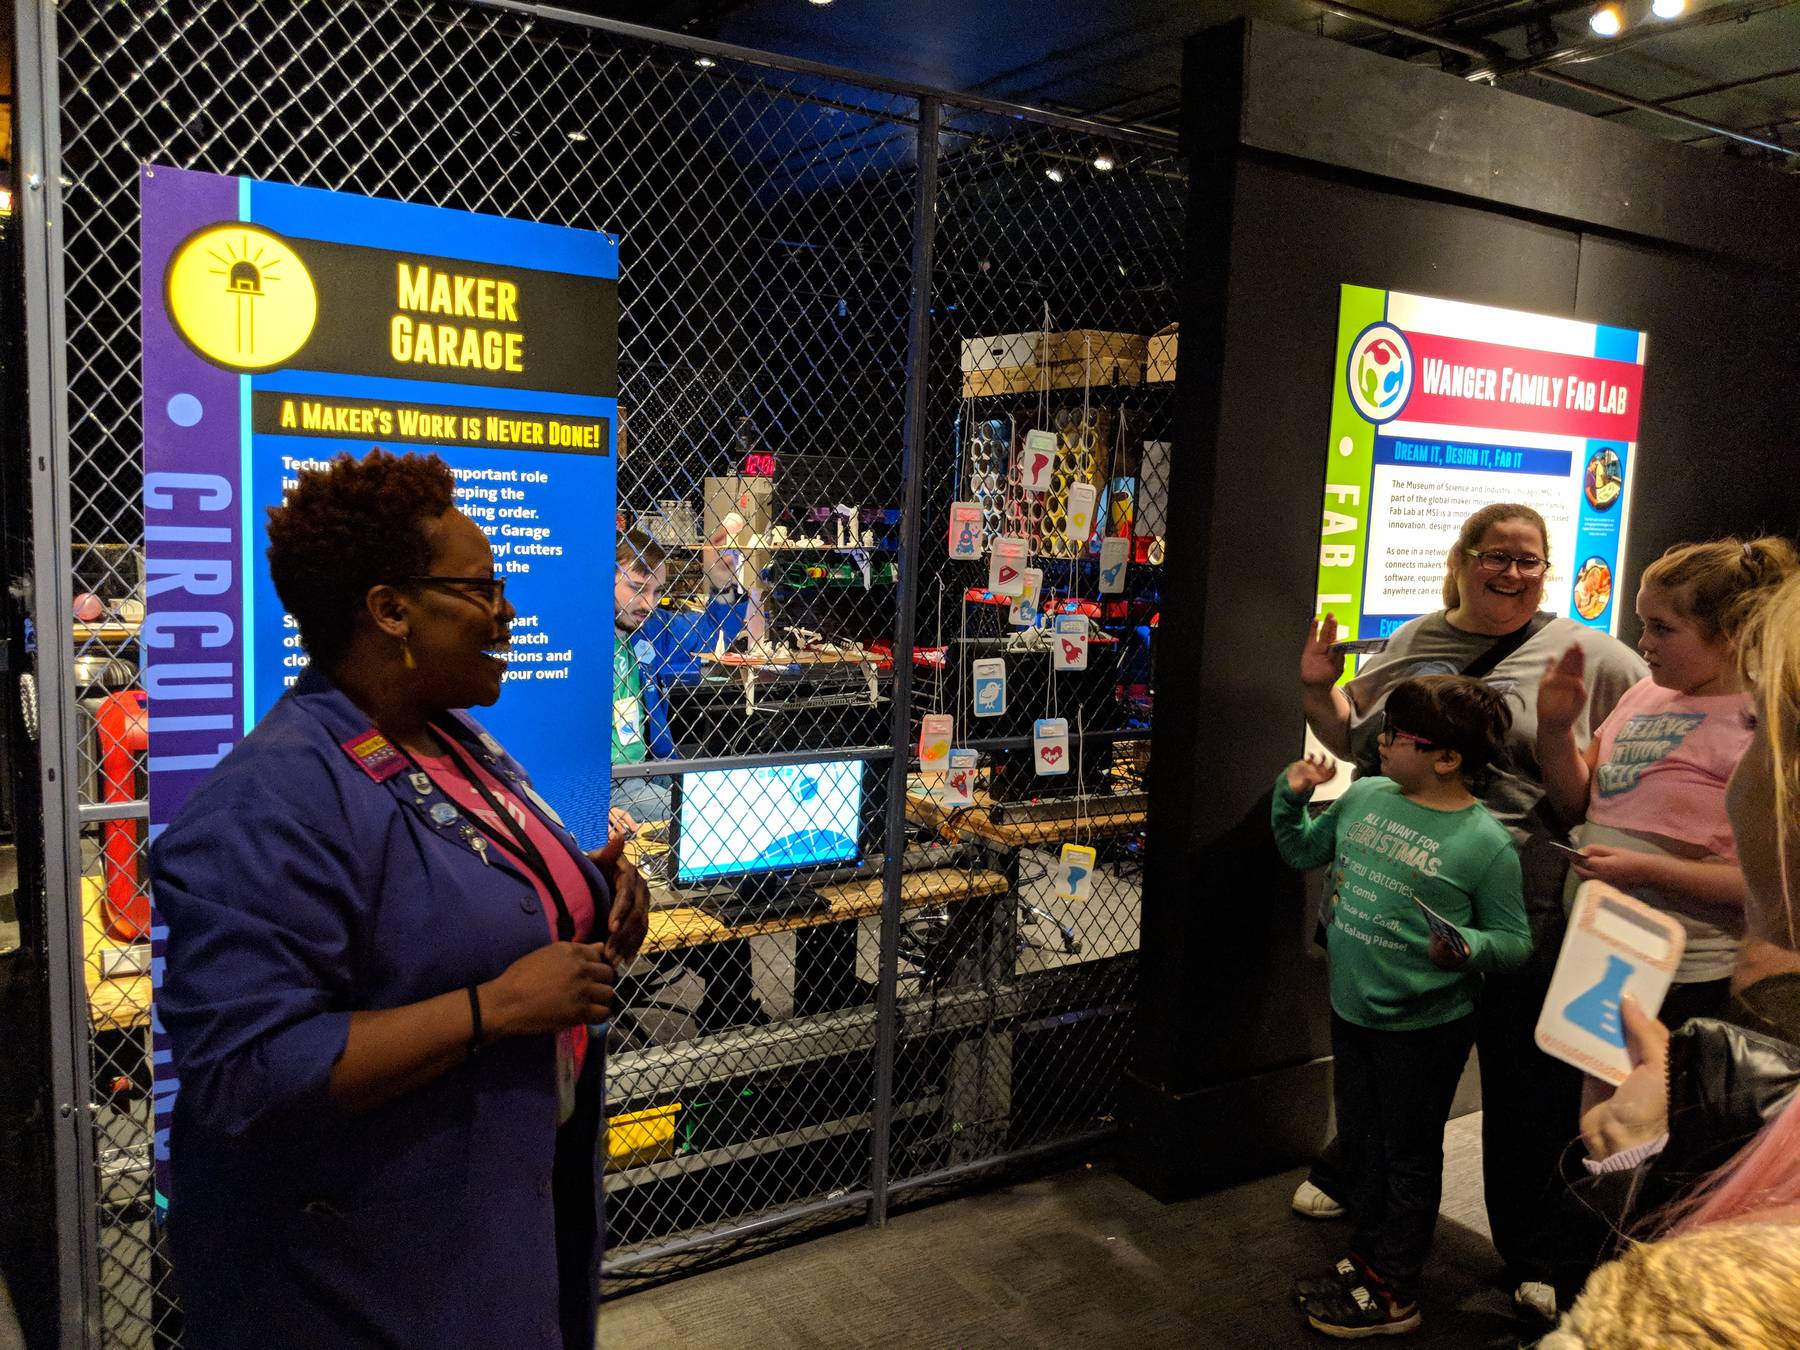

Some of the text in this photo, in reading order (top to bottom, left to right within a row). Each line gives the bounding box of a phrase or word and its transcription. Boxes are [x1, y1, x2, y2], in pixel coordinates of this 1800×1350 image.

[397, 262, 519, 322] MAKER
[390, 314, 525, 373] GARAGE
[1422, 357, 1628, 416] WANGER FAMILY FAB LAB
[280, 400, 601, 449] A MAKER'S WORK IS NEVER DONE!
[1394, 440, 1428, 462] DREAM
[1445, 444, 1479, 466] DESIGN
[1494, 448, 1512, 468] FAB
[1514, 452, 1524, 469] IT
[281, 455, 549, 483] Techn mportant role
[451, 485, 498, 503] eeping
[500, 487, 525, 500] the
[1392, 479, 1405, 489] The
[1406, 481, 1435, 491] Museum
[1436, 482, 1444, 491] of
[1445, 482, 1470, 492] Science
[1470, 485, 1483, 493] and
[1390, 494, 1406, 504] part
[1407, 494, 1415, 503] of
[1416, 494, 1428, 503] the
[1428, 495, 1450, 506] global
[1451, 496, 1472, 505] maker
[456, 503, 540, 521] rking order.
[1389, 507, 1402, 516] Fab
[1403, 508, 1416, 517] Lab
[1417, 508, 1425, 517] at
[1425, 508, 1439, 518] MSI
[501, 524, 551, 541] Garage
[1321, 484, 1361, 568] FAB
[1429, 522, 1451, 532] design
[490, 542, 564, 557] nyl cutters
[1386, 547, 1396, 556] As
[1396, 548, 1410, 556] one
[1410, 547, 1418, 556] in
[1424, 549, 1449, 557] networ
[505, 560, 530, 573] the
[1384, 561, 1416, 569] connects
[1417, 561, 1442, 569] makers
[1417, 575, 1444, 584] equipm
[1382, 587, 1417, 597] anywhere
[1417, 588, 1430, 596] can
[283, 634, 303, 648] of
[545, 649, 572, 662] and
[501, 667, 569, 684] your own!
[1362, 812, 1441, 853] ALL I WANT FOR
[1346, 821, 1443, 877] CHRISTMAS
[1352, 885, 1378, 902] comb
[1344, 923, 1372, 945] Galaxy
